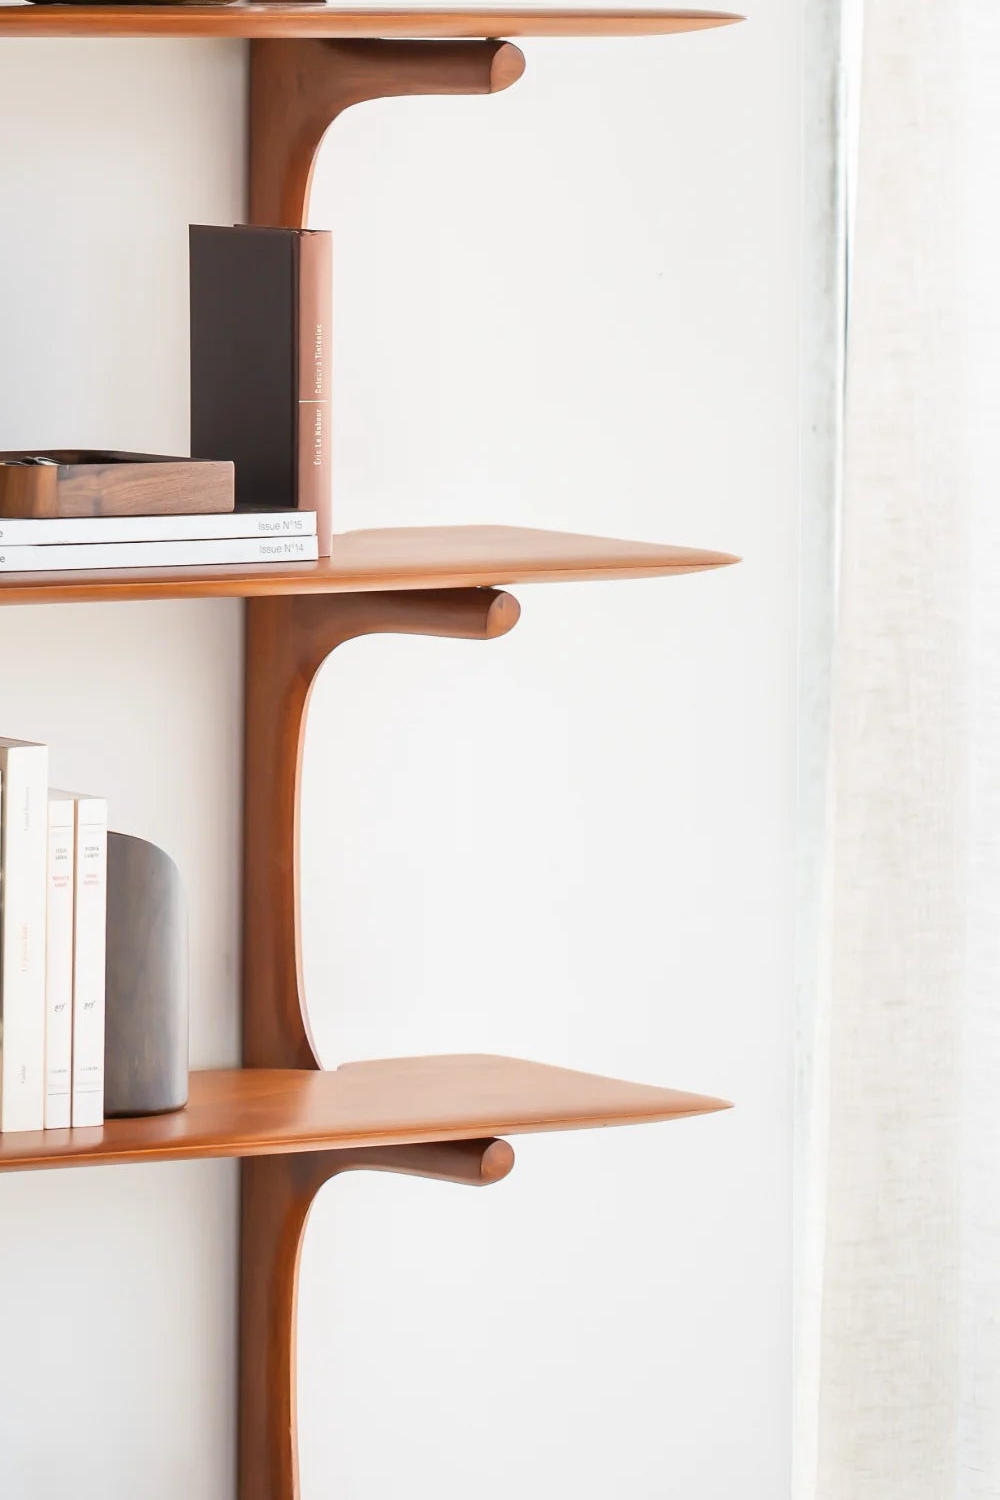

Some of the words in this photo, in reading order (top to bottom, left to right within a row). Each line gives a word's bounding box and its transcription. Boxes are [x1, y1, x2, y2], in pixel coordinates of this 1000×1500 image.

[314, 438, 322, 448] Le
[258, 522, 281, 531] Issue
[259, 545, 283, 554] Issue
